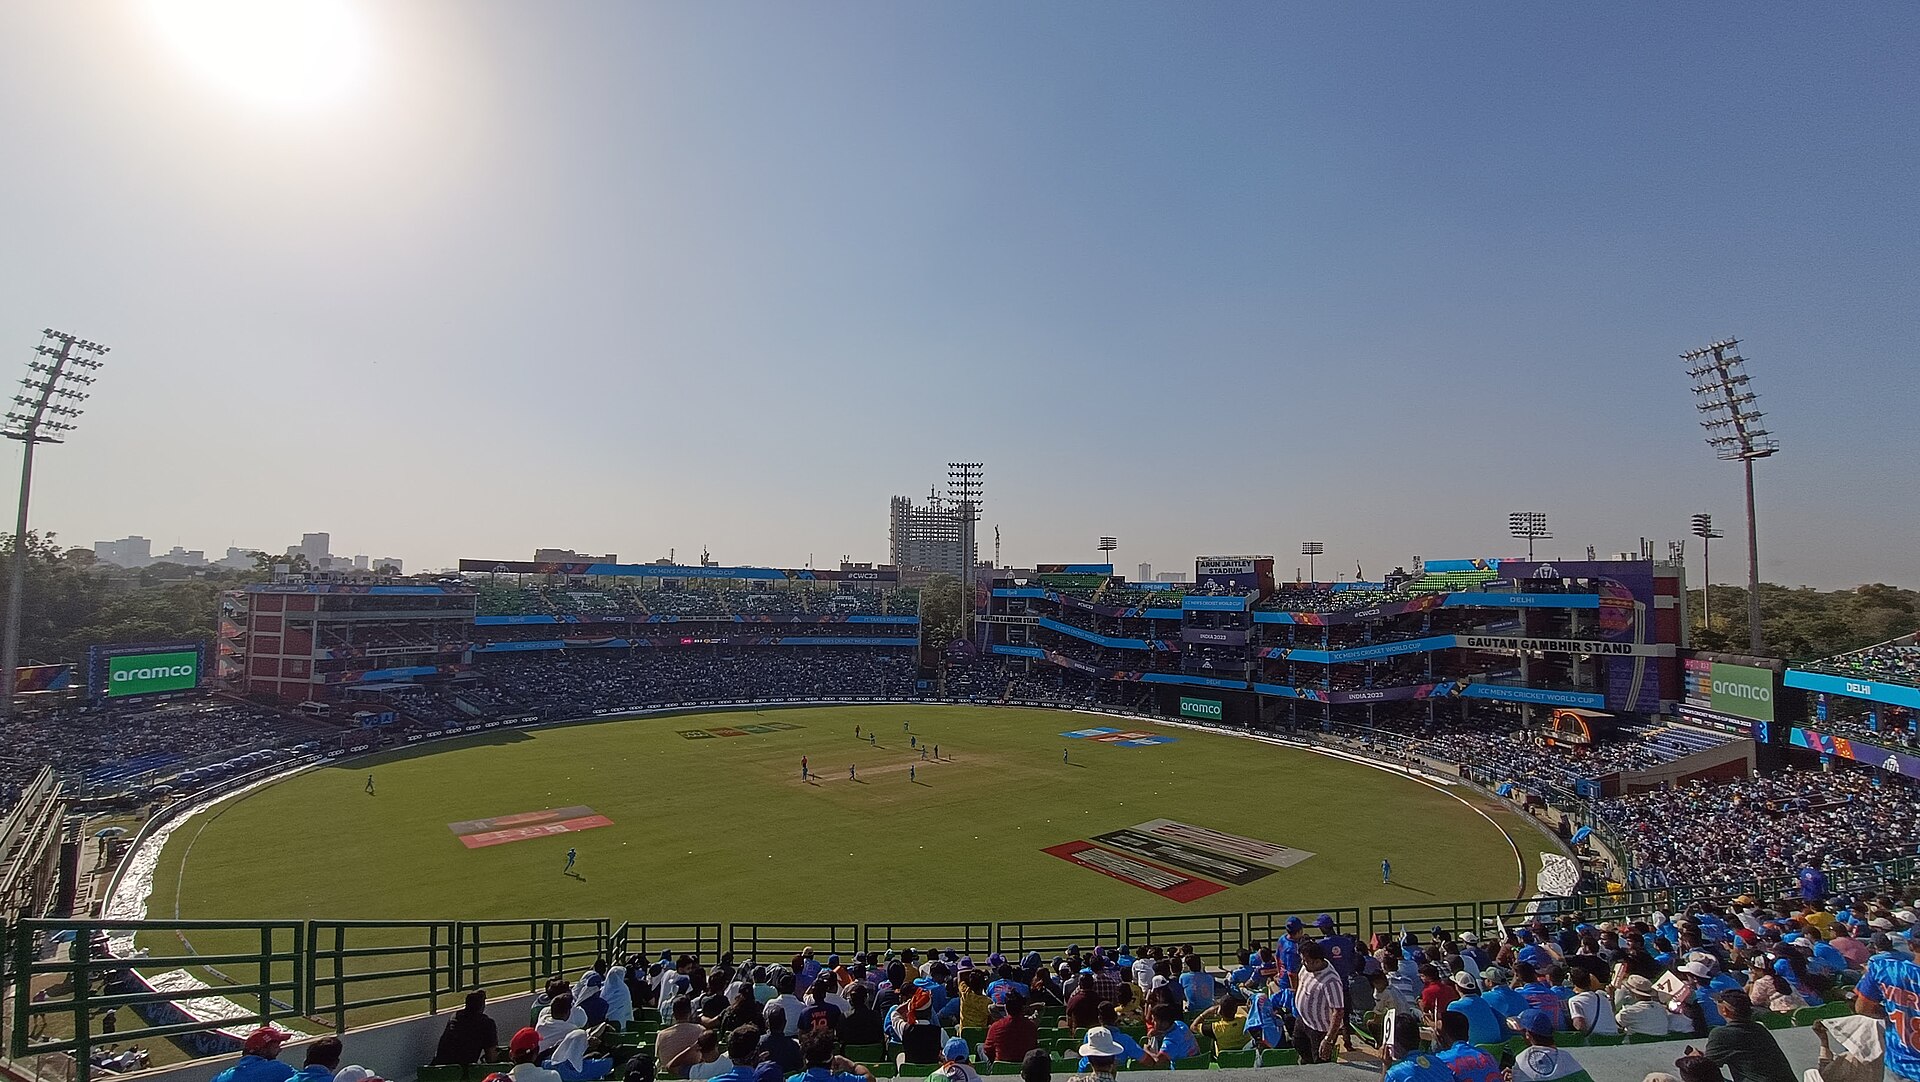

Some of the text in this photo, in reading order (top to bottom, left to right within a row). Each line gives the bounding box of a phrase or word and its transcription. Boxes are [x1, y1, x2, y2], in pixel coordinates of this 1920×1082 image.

[1200, 560, 1220, 568] ARUN
[1509, 596, 1535, 604] DELHI
[1354, 608, 1380, 618] #CWC23
[1343, 650, 1360, 659] MEN'S
[1360, 647, 1384, 656] CRICKET
[1385, 644, 1408, 653] WORLD
[1467, 637, 1632, 654] GAUTAM GAMBHIR STAND
[113, 665, 192, 681] aramco
[1713, 680, 1770, 702] aramco
[1846, 682, 1871, 695] DELHI
[1367, 691, 1384, 699] 2023
[1490, 688, 1512, 697] MEN'S
[1514, 691, 1545, 699] CRICKET
[1547, 694, 1576, 702] WORLD
[1577, 696, 1594, 704] CUP
[1181, 702, 1220, 714] aramco
[426, 730, 442, 738] oppo
